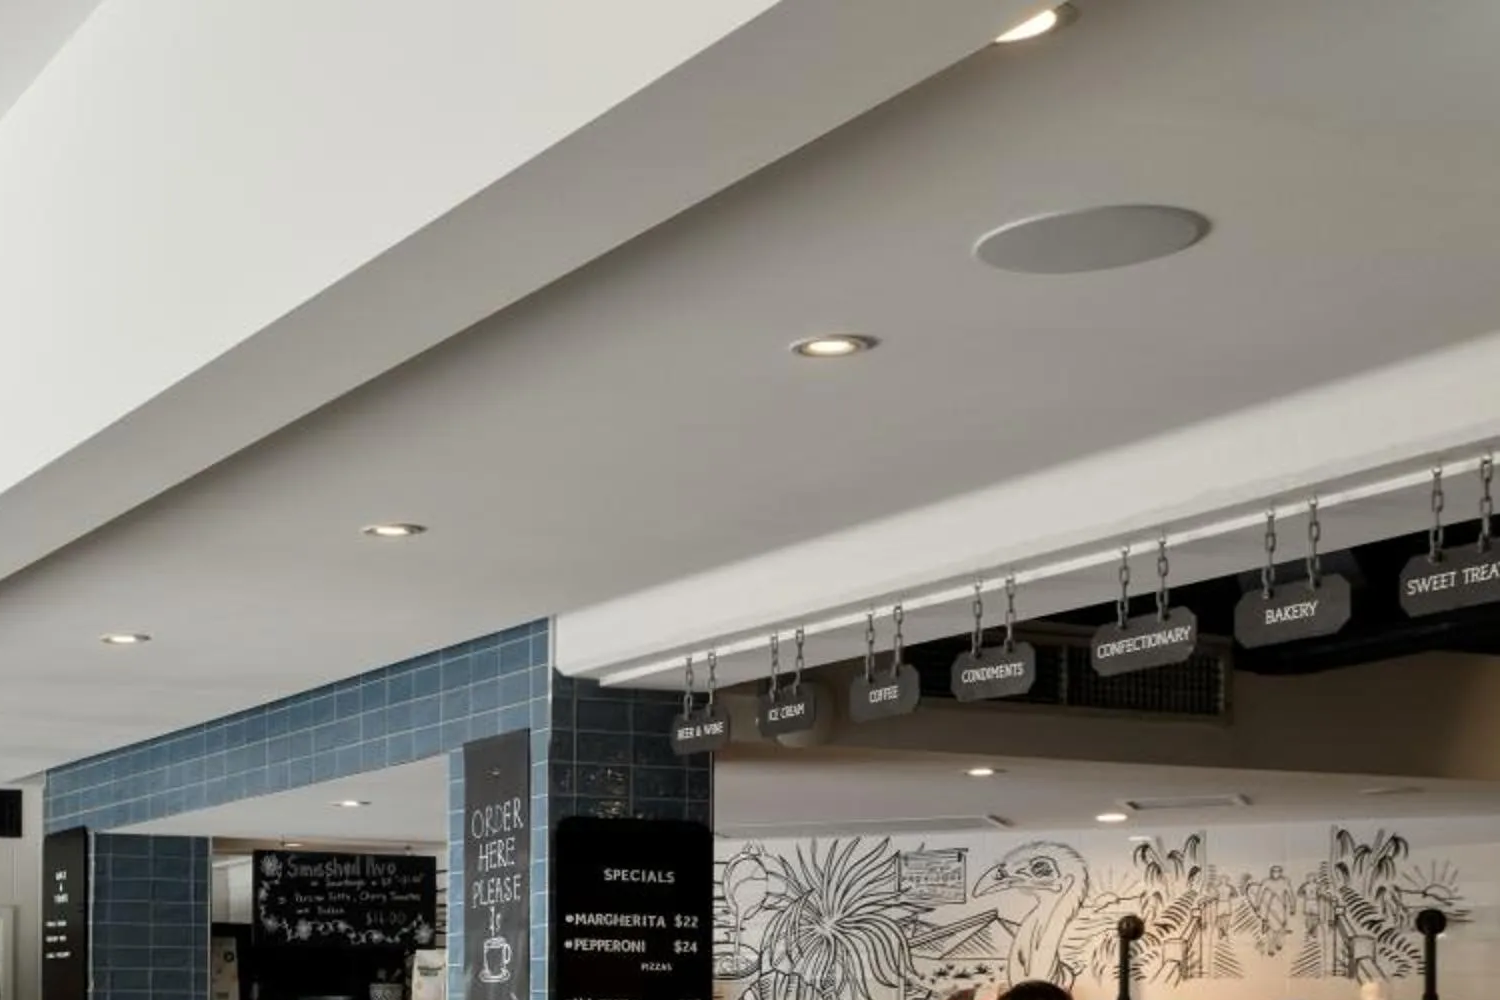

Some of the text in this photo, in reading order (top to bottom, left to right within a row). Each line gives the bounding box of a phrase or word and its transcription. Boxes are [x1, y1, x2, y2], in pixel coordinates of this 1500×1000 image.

[1406, 560, 1500, 596] SWEET TREA
[1265, 601, 1319, 625] BAKERY
[1097, 626, 1192, 659] CONFECTIONARY
[961, 662, 1025, 683] CONDIMENTS
[868, 684, 900, 704] COFFEE
[780, 702, 805, 719] CREAM
[703, 721, 725, 736] WINE
[471, 797, 524, 839] ORDER
[287, 853, 361, 878] Smashed
[477, 837, 516, 872] HERE
[603, 867, 676, 884] SPECIALS
[471, 874, 522, 909] PLEASE
[574, 912, 700, 929] MARGHERITA $22
[573, 937, 699, 955] PEPPERONI $24
